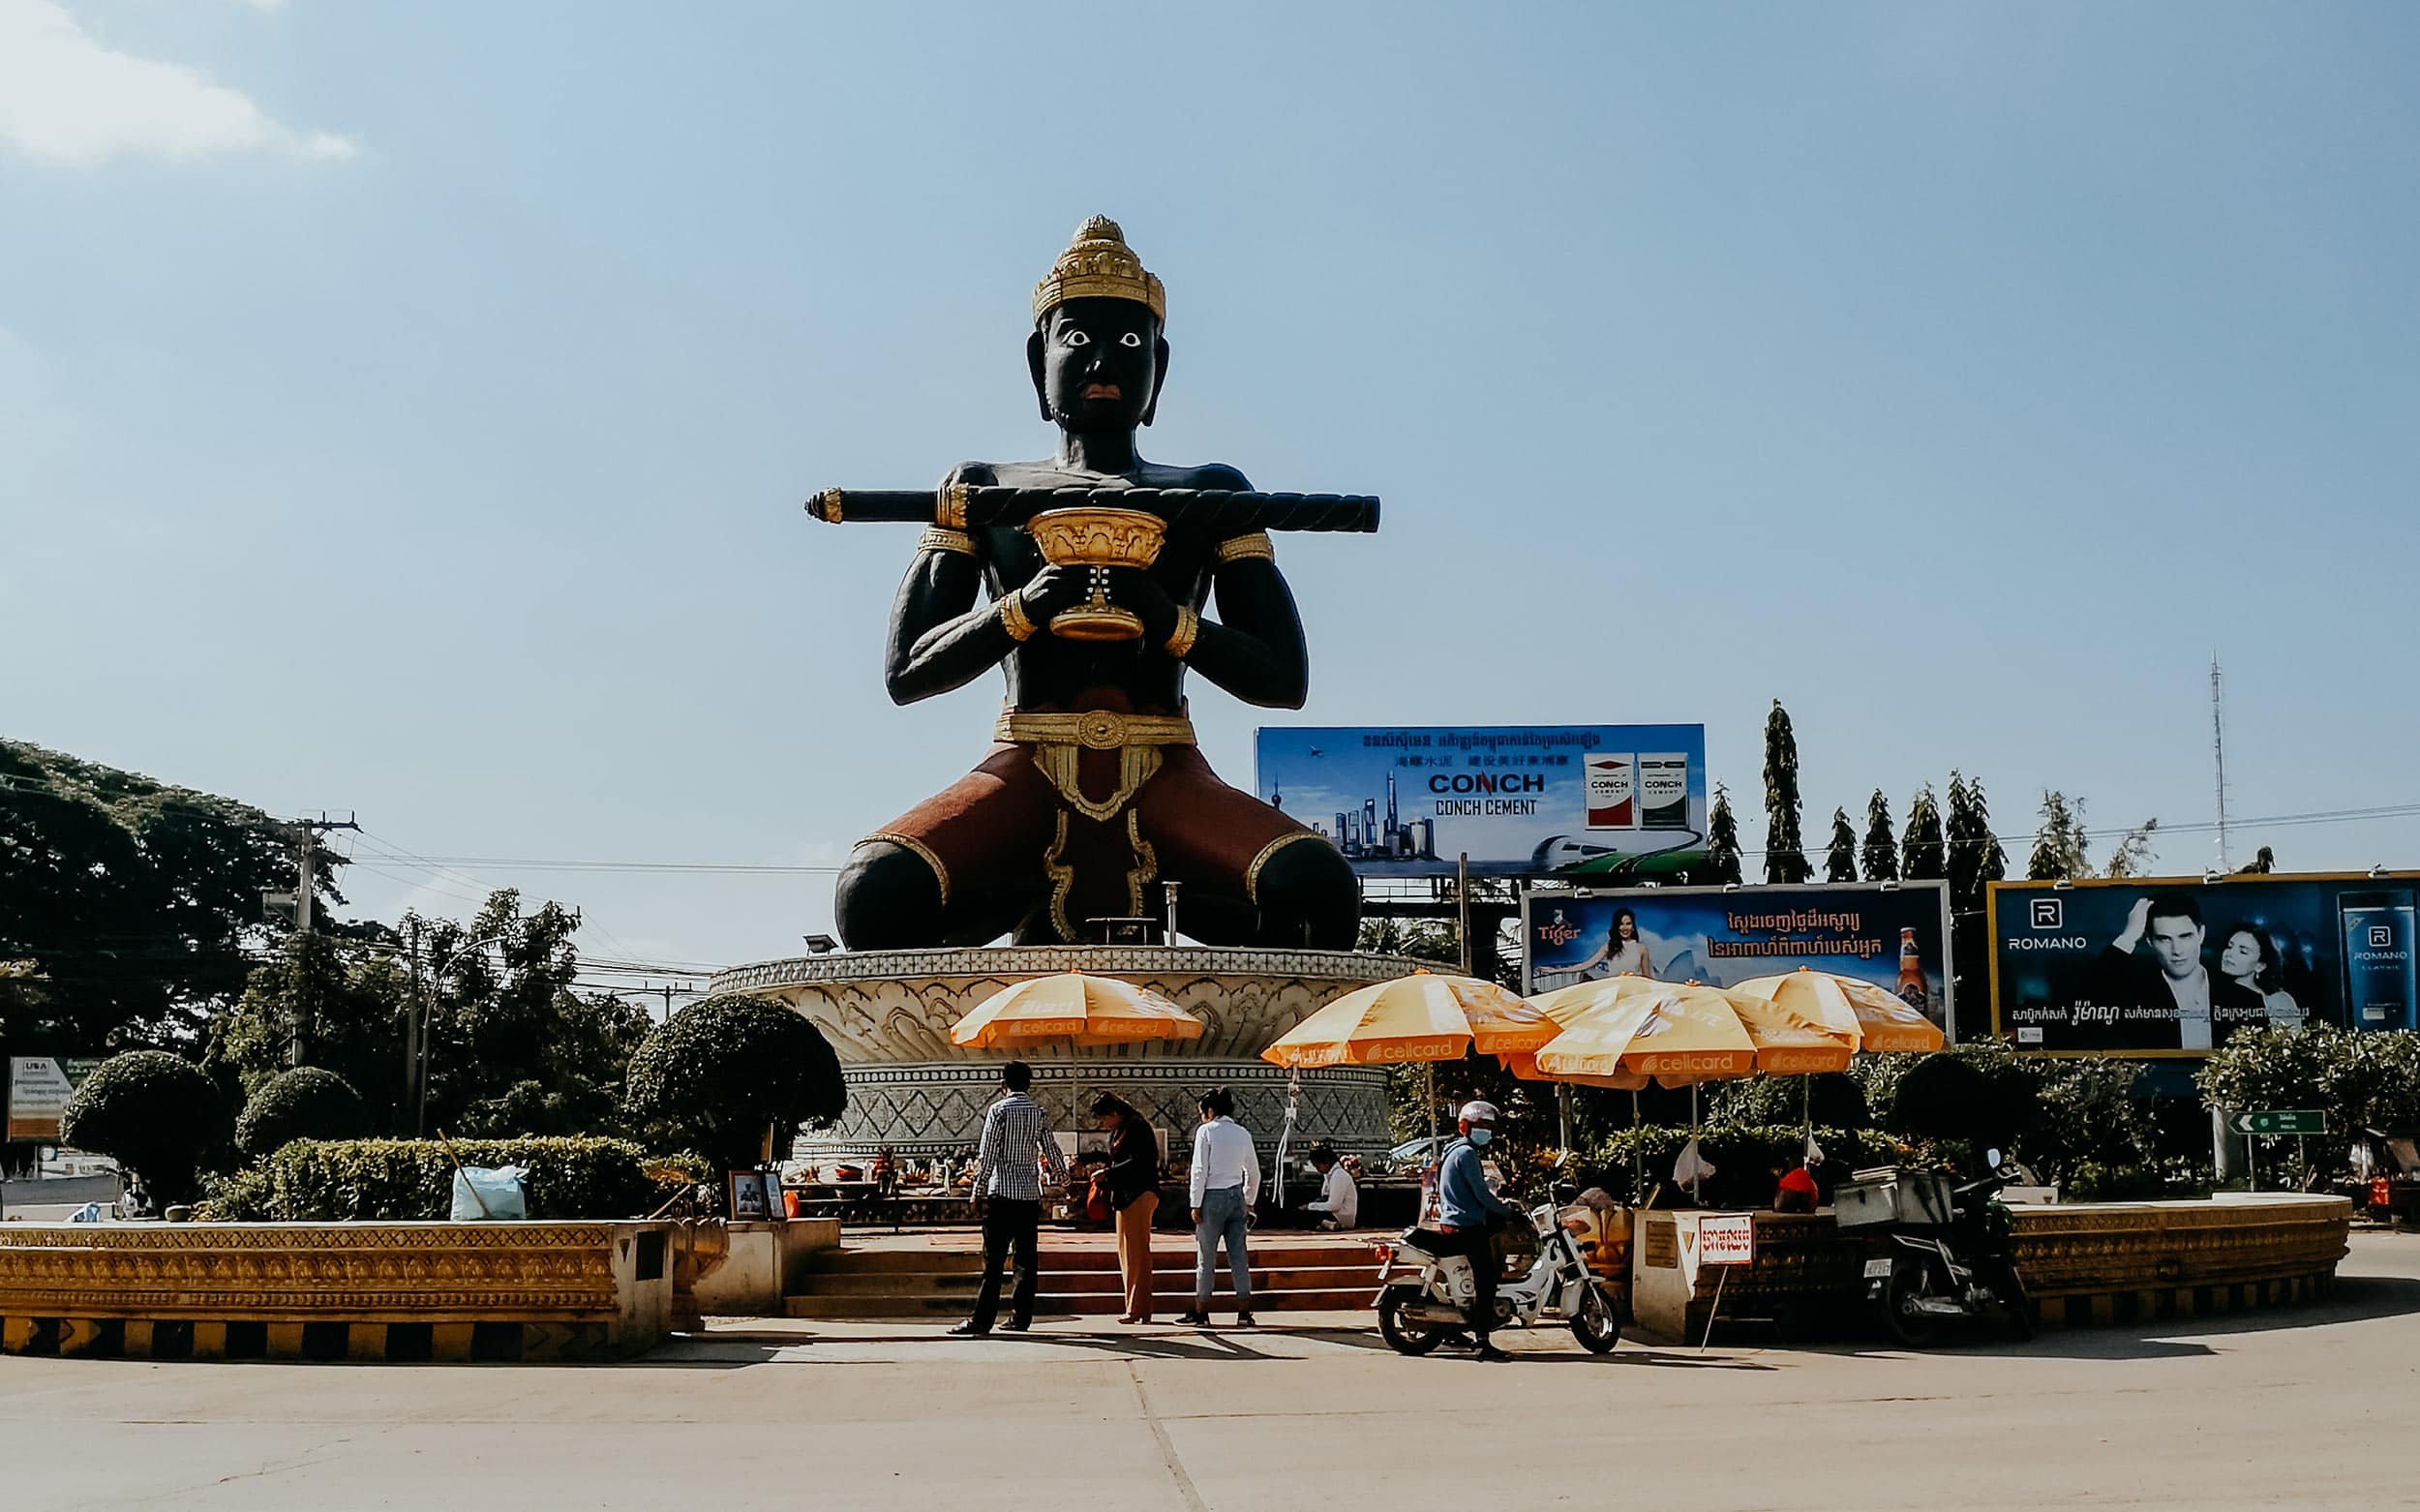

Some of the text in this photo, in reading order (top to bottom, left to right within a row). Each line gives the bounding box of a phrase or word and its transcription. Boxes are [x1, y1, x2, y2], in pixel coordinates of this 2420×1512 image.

[1429, 771, 1544, 795] CONCH
[1645, 780, 1681, 789] CONCH
[1436, 799, 1537, 815] CONCH CEMENT
[1538, 924, 1582, 946] Tiger
[2009, 936, 2087, 951] ROMANO
[2354, 951, 2408, 961] ROMANO
[1384, 1041, 1453, 1060] cellcard
[1659, 1053, 1733, 1071] cellcard
[1782, 1053, 1838, 1068] cellcard
